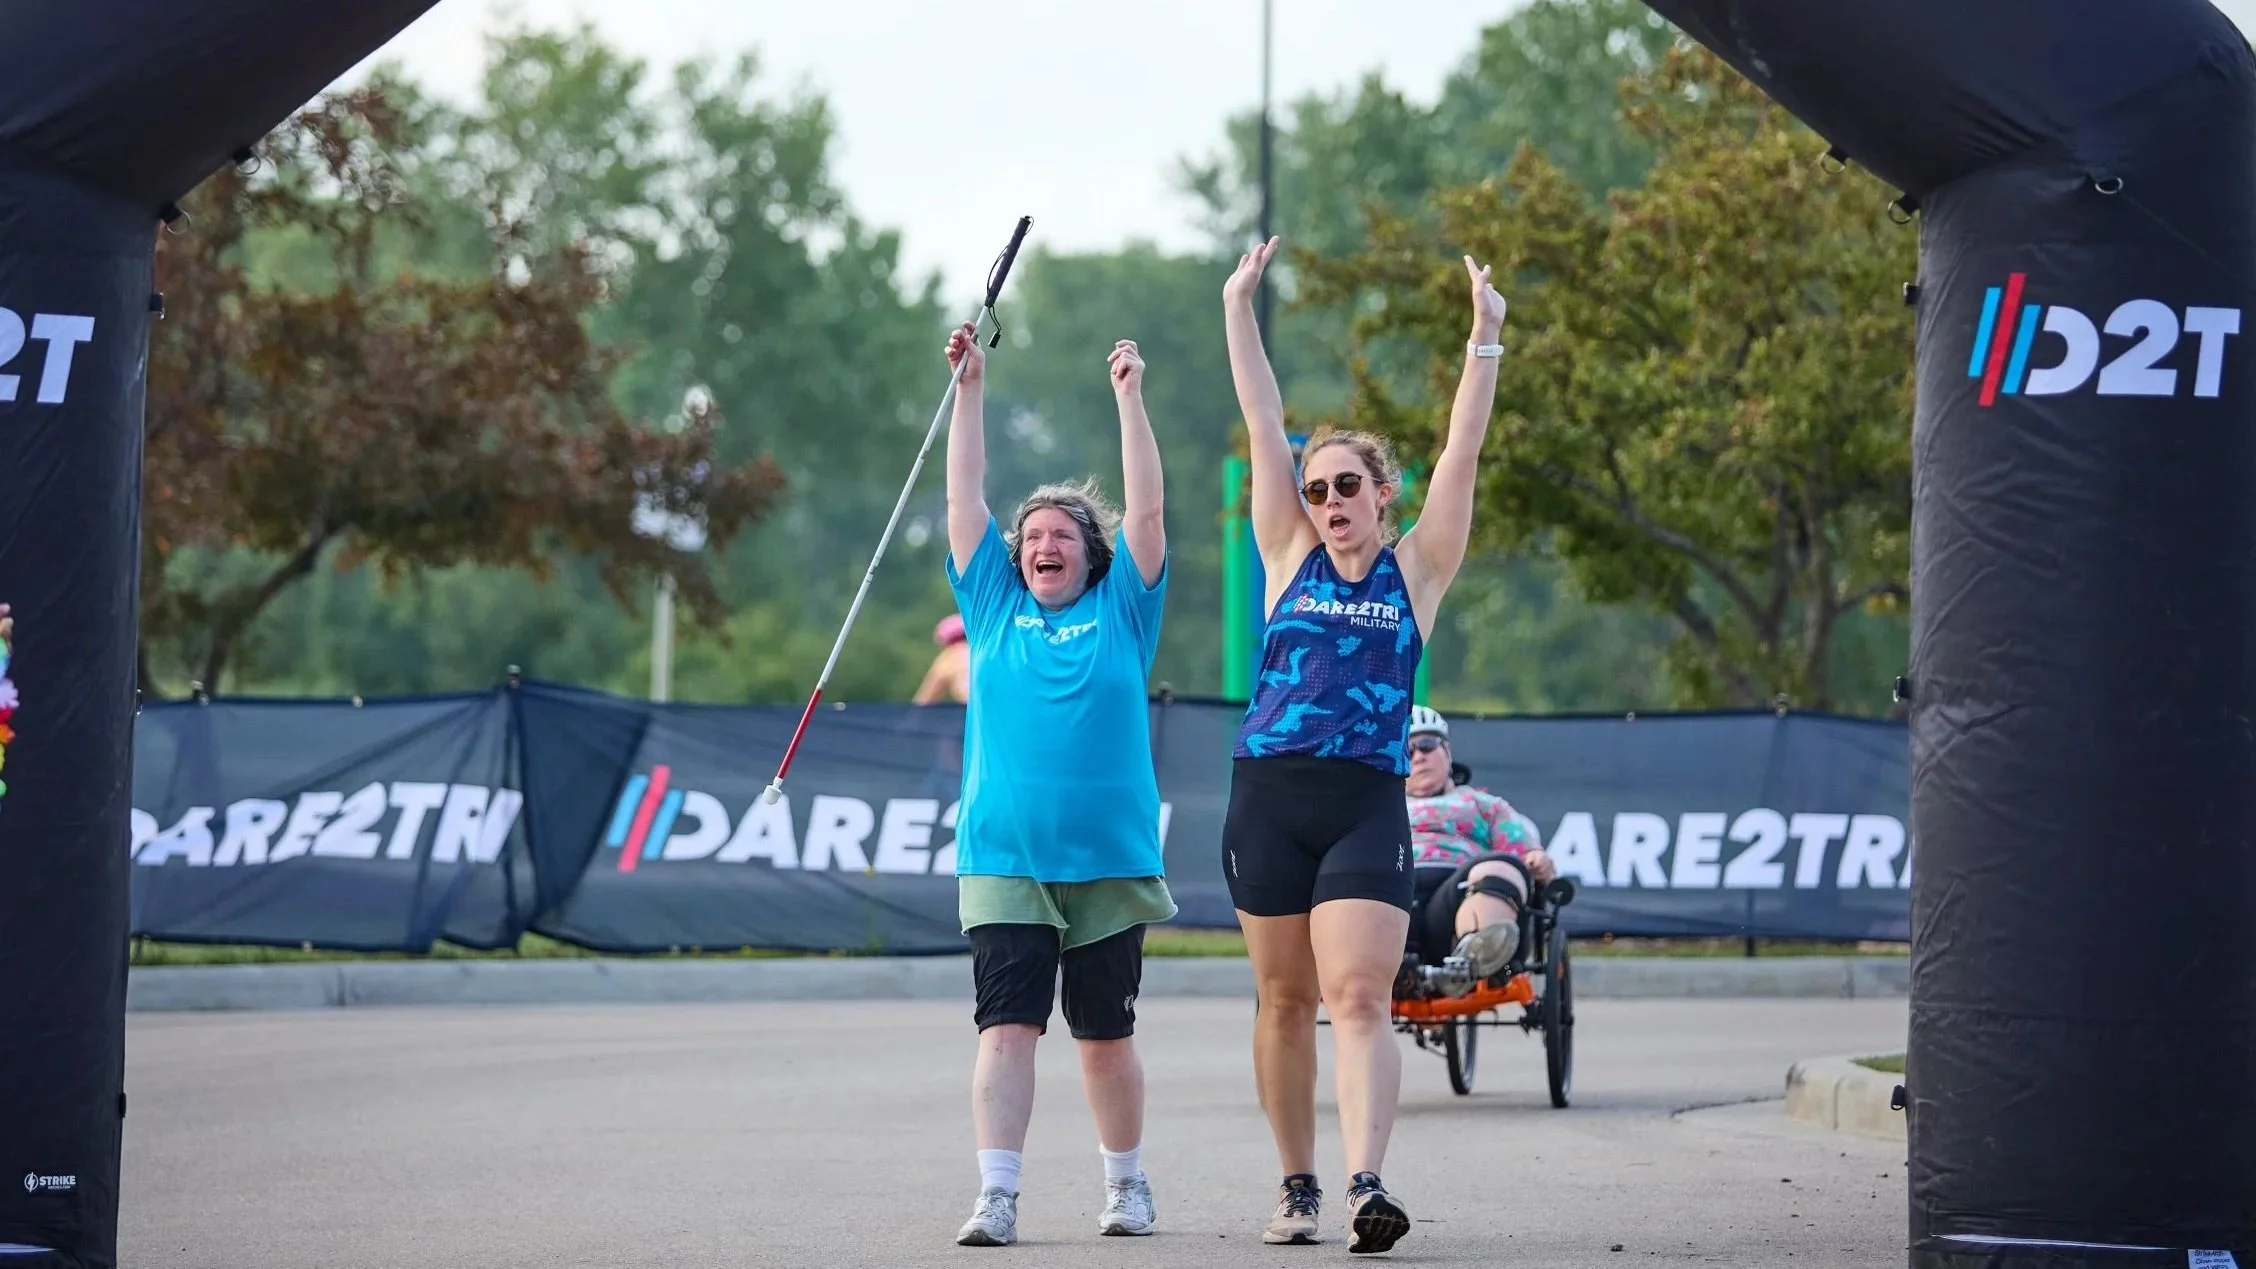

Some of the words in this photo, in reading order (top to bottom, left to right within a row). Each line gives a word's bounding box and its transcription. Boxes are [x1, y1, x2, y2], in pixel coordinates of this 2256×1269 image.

[2024, 298, 2241, 397] D2T
[1300, 597, 1399, 620] DARE2TRI
[1350, 616, 1401, 632] MILITARY
[39, 1175, 76, 1186] STRIKE
